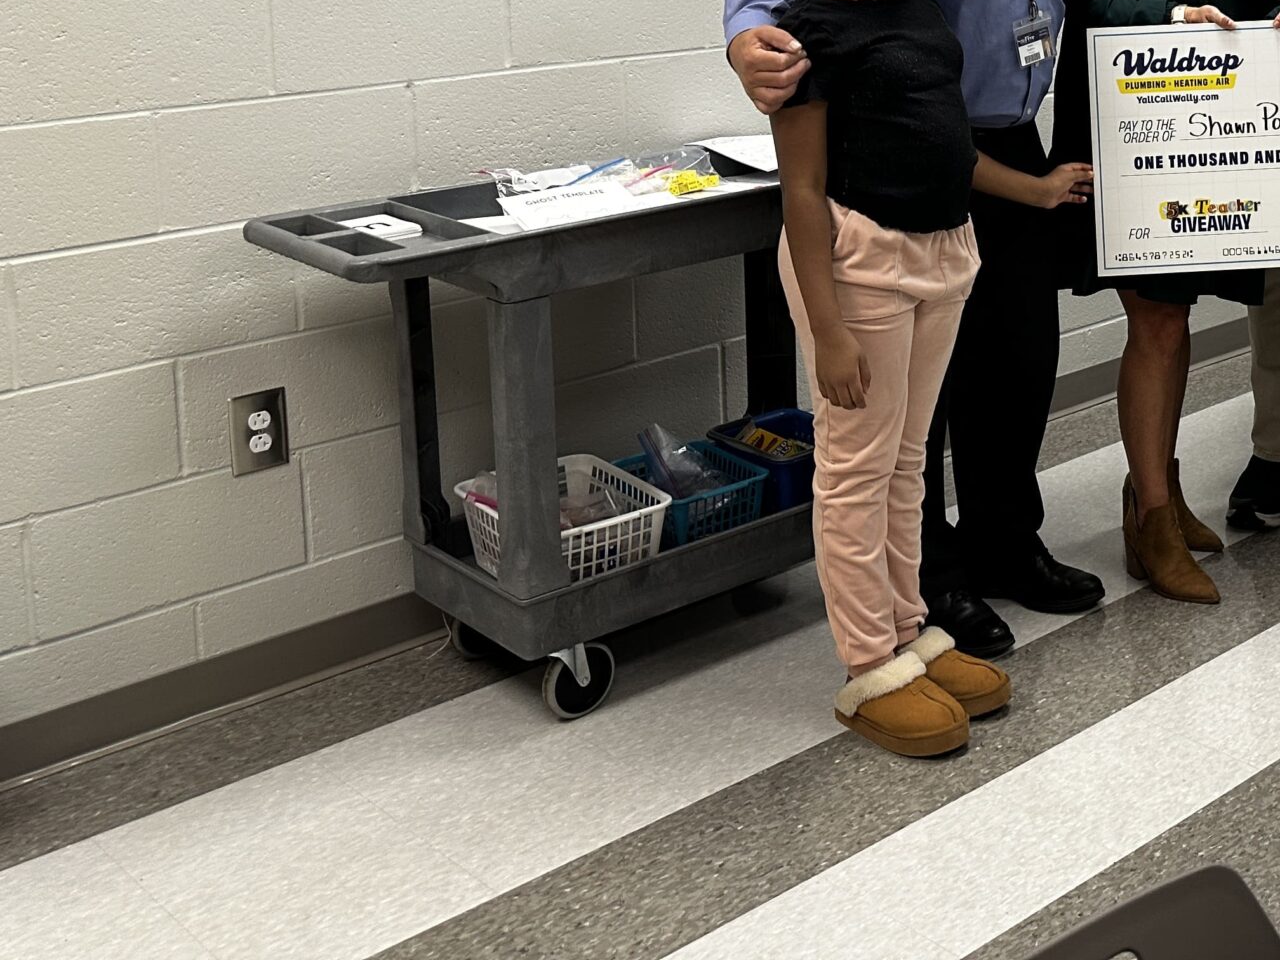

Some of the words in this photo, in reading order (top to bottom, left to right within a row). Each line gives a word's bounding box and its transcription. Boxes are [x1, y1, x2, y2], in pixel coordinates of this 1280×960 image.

[1112, 47, 1244, 77] Waldrop
[1125, 81, 1166, 90] PLUMBING
[1174, 78, 1208, 87] HEATING
[1216, 77, 1230, 86] AIR
[1136, 94, 1219, 104] YallCallWally.com
[1119, 120, 1138, 132] PAY
[1140, 120, 1153, 131] TO
[1156, 119, 1176, 131] THE
[1189, 112, 1257, 137] Shawn
[1123, 132, 1159, 143] ORDER
[1162, 130, 1176, 142] OF
[1134, 156, 1163, 170] ONE
[1168, 151, 1250, 168] THOUSAND
[525, 195, 558, 206] GHOST
[561, 189, 604, 199] TEMPLATE
[1195, 198, 1261, 214] Teacher
[1170, 213, 1251, 233] GIVEAWAY
[1128, 228, 1150, 240] FOR
